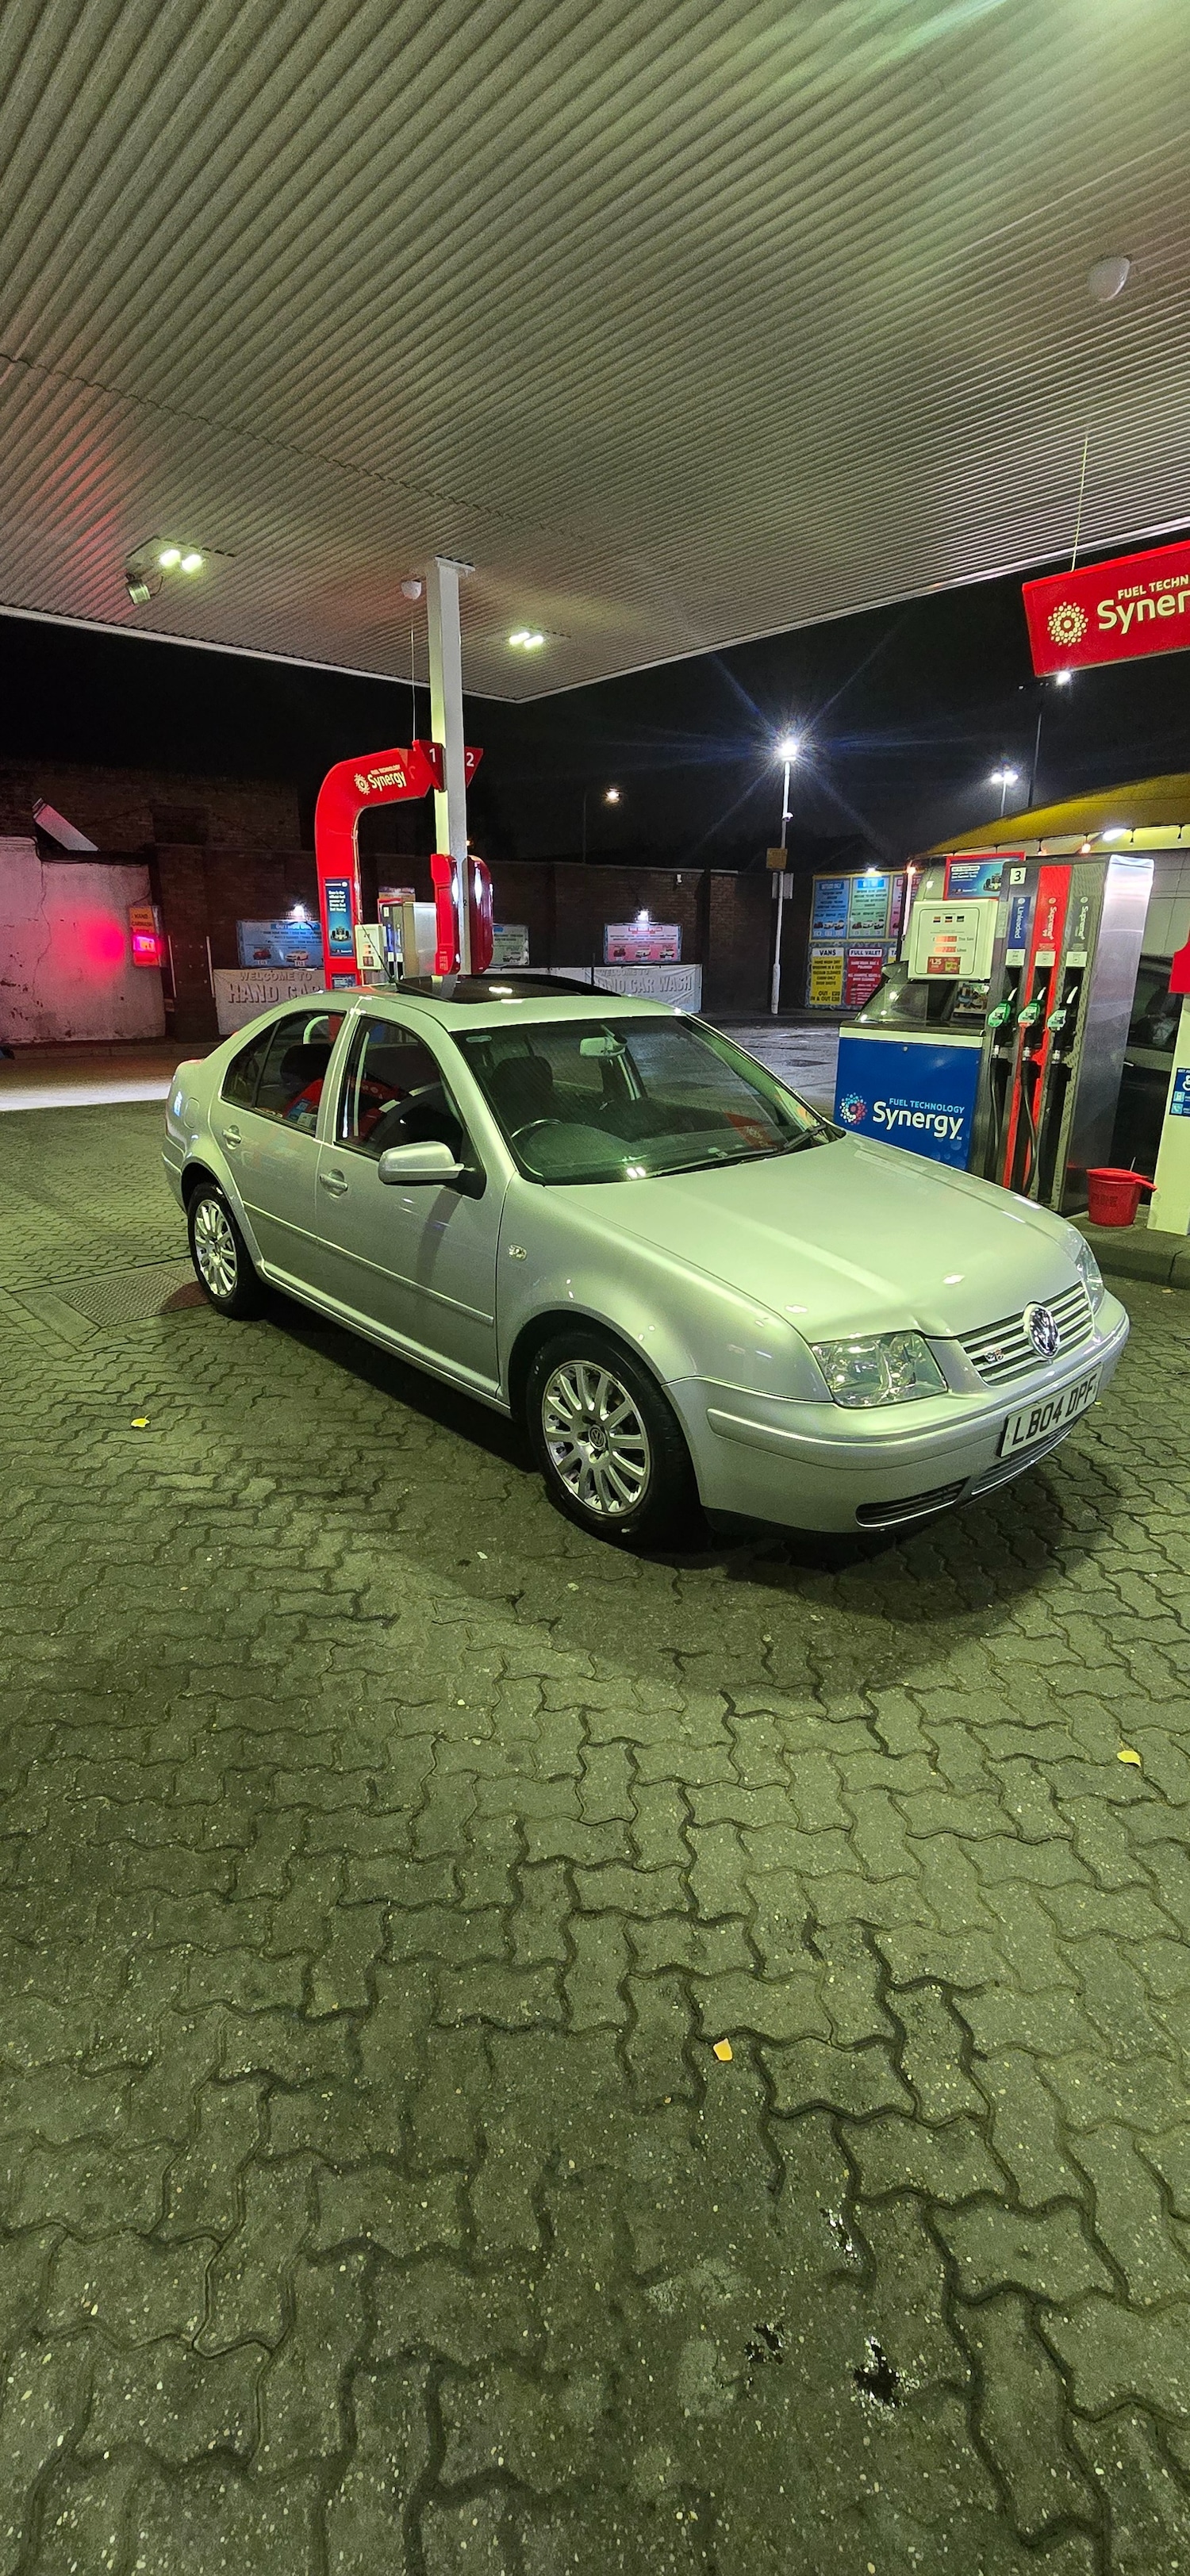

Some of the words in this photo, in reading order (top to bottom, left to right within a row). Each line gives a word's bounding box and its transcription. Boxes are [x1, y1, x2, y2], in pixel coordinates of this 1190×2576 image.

[1118, 585, 1146, 600] FUEL
[429, 748, 436, 763] 1
[466, 752, 474, 767] 2
[367, 770, 407, 792] Synergy
[1014, 870, 1022, 881] 3
[1014, 906, 1025, 939] Unleaded
[240, 972, 295, 981] WELCOME
[298, 972, 313, 981] TO
[631, 979, 654, 993] CAR
[659, 975, 693, 992] WASH
[228, 983, 279, 1004] HAND
[889, 1097, 908, 1108] FUEL
[910, 1100, 965, 1114] TECHNOLOGY
[873, 1100, 964, 1140] Synergy
[1012, 1395, 1065, 1445] LB04
[1065, 1373, 1097, 1418] DPF
